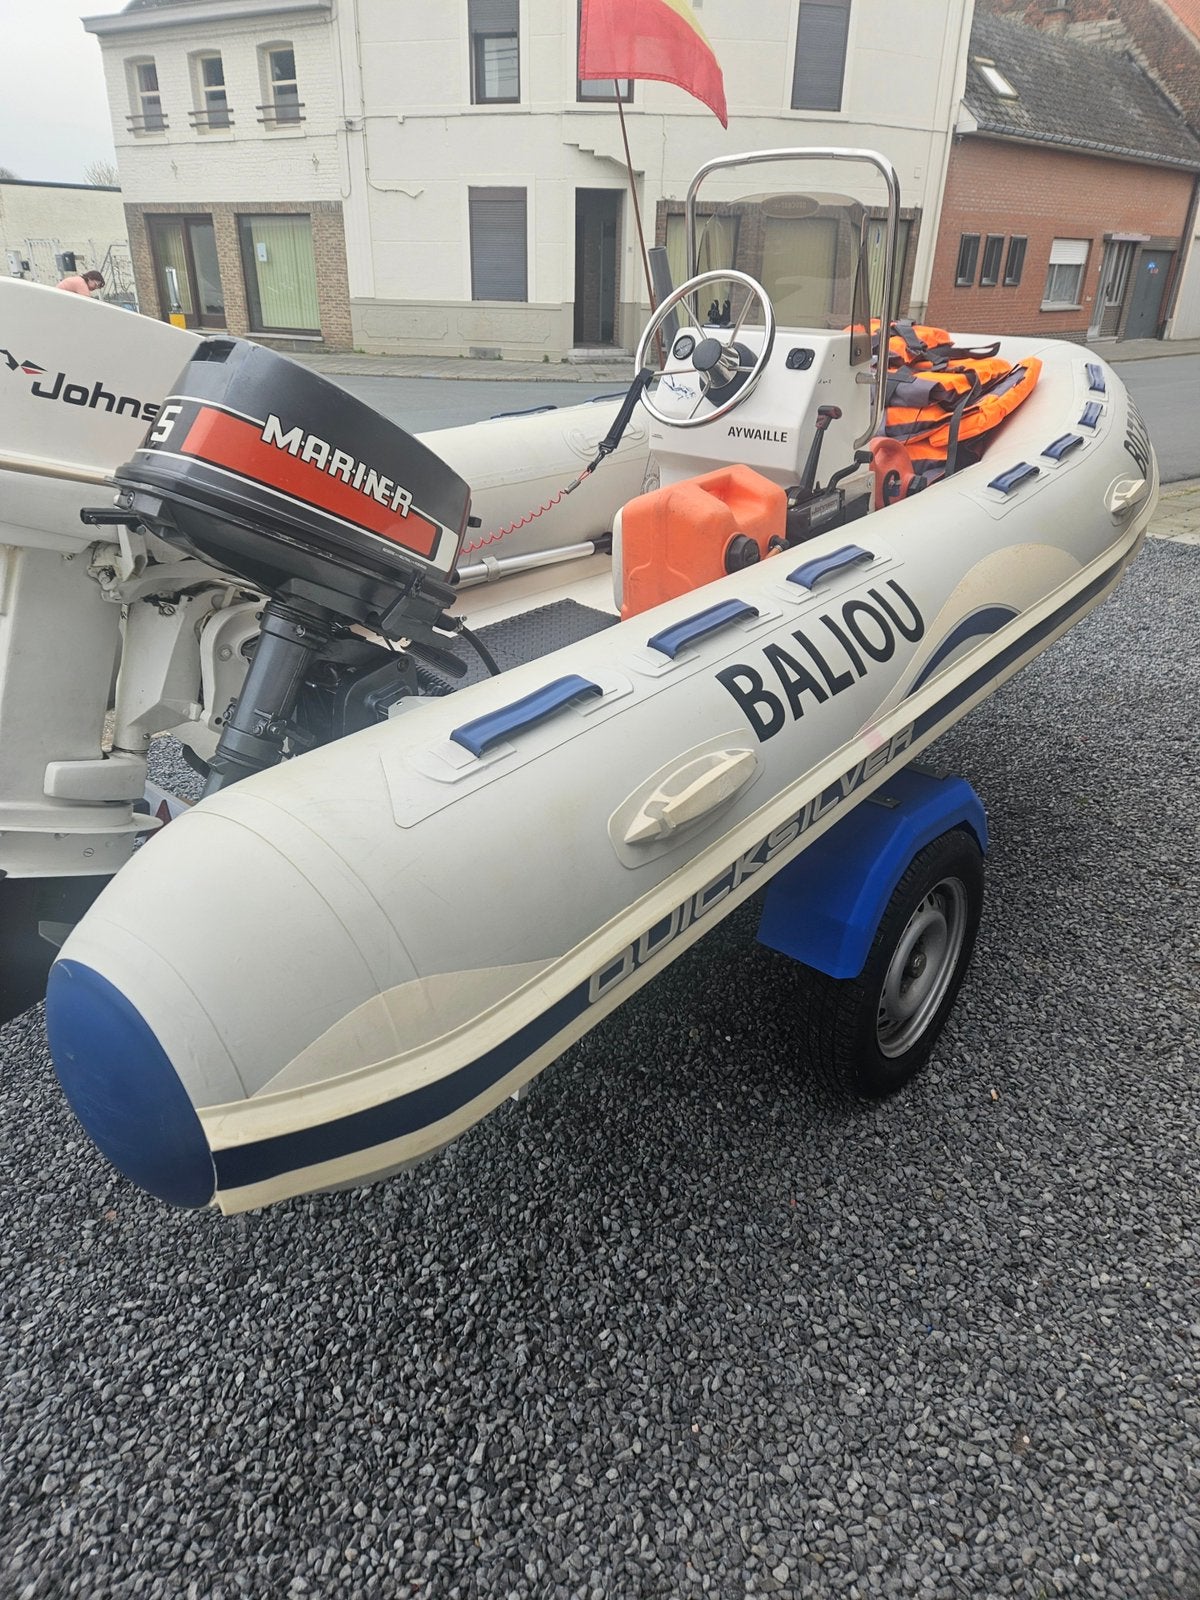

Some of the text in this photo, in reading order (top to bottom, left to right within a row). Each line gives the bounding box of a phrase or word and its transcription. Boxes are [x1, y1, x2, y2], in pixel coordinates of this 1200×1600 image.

[261, 413, 413, 518] MARINER
[727, 426, 788, 443] AYWAILLE
[715, 579, 925, 743] BALIOU
[588, 721, 916, 1004] QUICKSILVER
